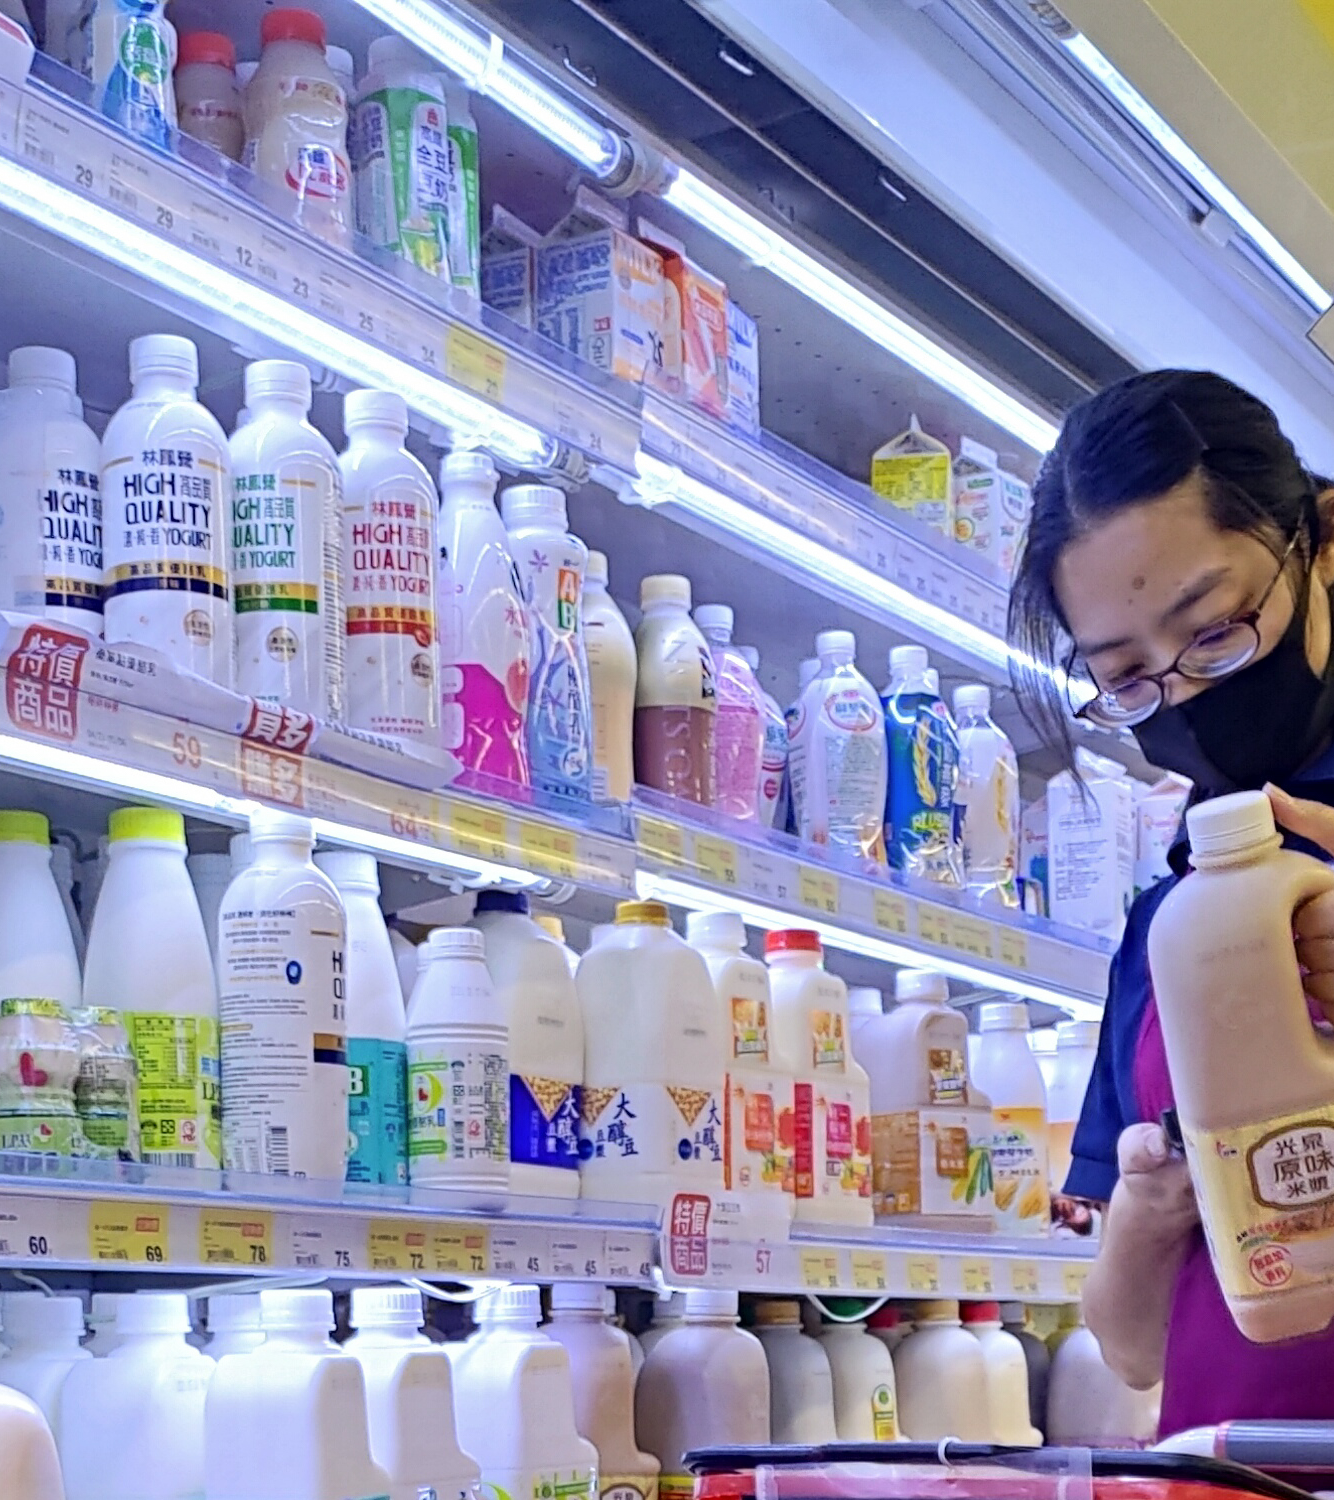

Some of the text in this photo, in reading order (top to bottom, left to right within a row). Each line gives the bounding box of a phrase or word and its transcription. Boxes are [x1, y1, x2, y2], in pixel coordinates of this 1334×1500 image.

[75, 164, 93, 188] 29
[156, 206, 173, 229] 29
[237, 246, 253, 268] 12
[294, 277, 308, 298] 23
[124, 473, 175, 498] HIGH
[125, 500, 211, 529] QUALITY
[163, 529, 212, 550] YOGURT
[353, 523, 403, 546] HIGH
[250, 551, 295, 568] YOGURT
[354, 549, 430, 576] QUALITY
[19, 630, 87, 687] 特價
[13, 677, 75, 738] 商品
[172, 731, 202, 770] 59
[1274, 1132, 1325, 1159] 光泉
[1286, 1178, 1332, 1199] 米漿
[674, 1201, 708, 1236] 特價
[28, 1236, 48, 1256] 60
[145, 1246, 163, 1263] 69
[249, 1246, 266, 1263] 78
[335, 1251, 350, 1268] 75
[410, 1254, 424, 1270] 72
[470, 1255, 484, 1271] 72
[527, 1257, 539, 1272] 45
[584, 1260, 597, 1276] 45
[756, 1250, 772, 1275] 57
